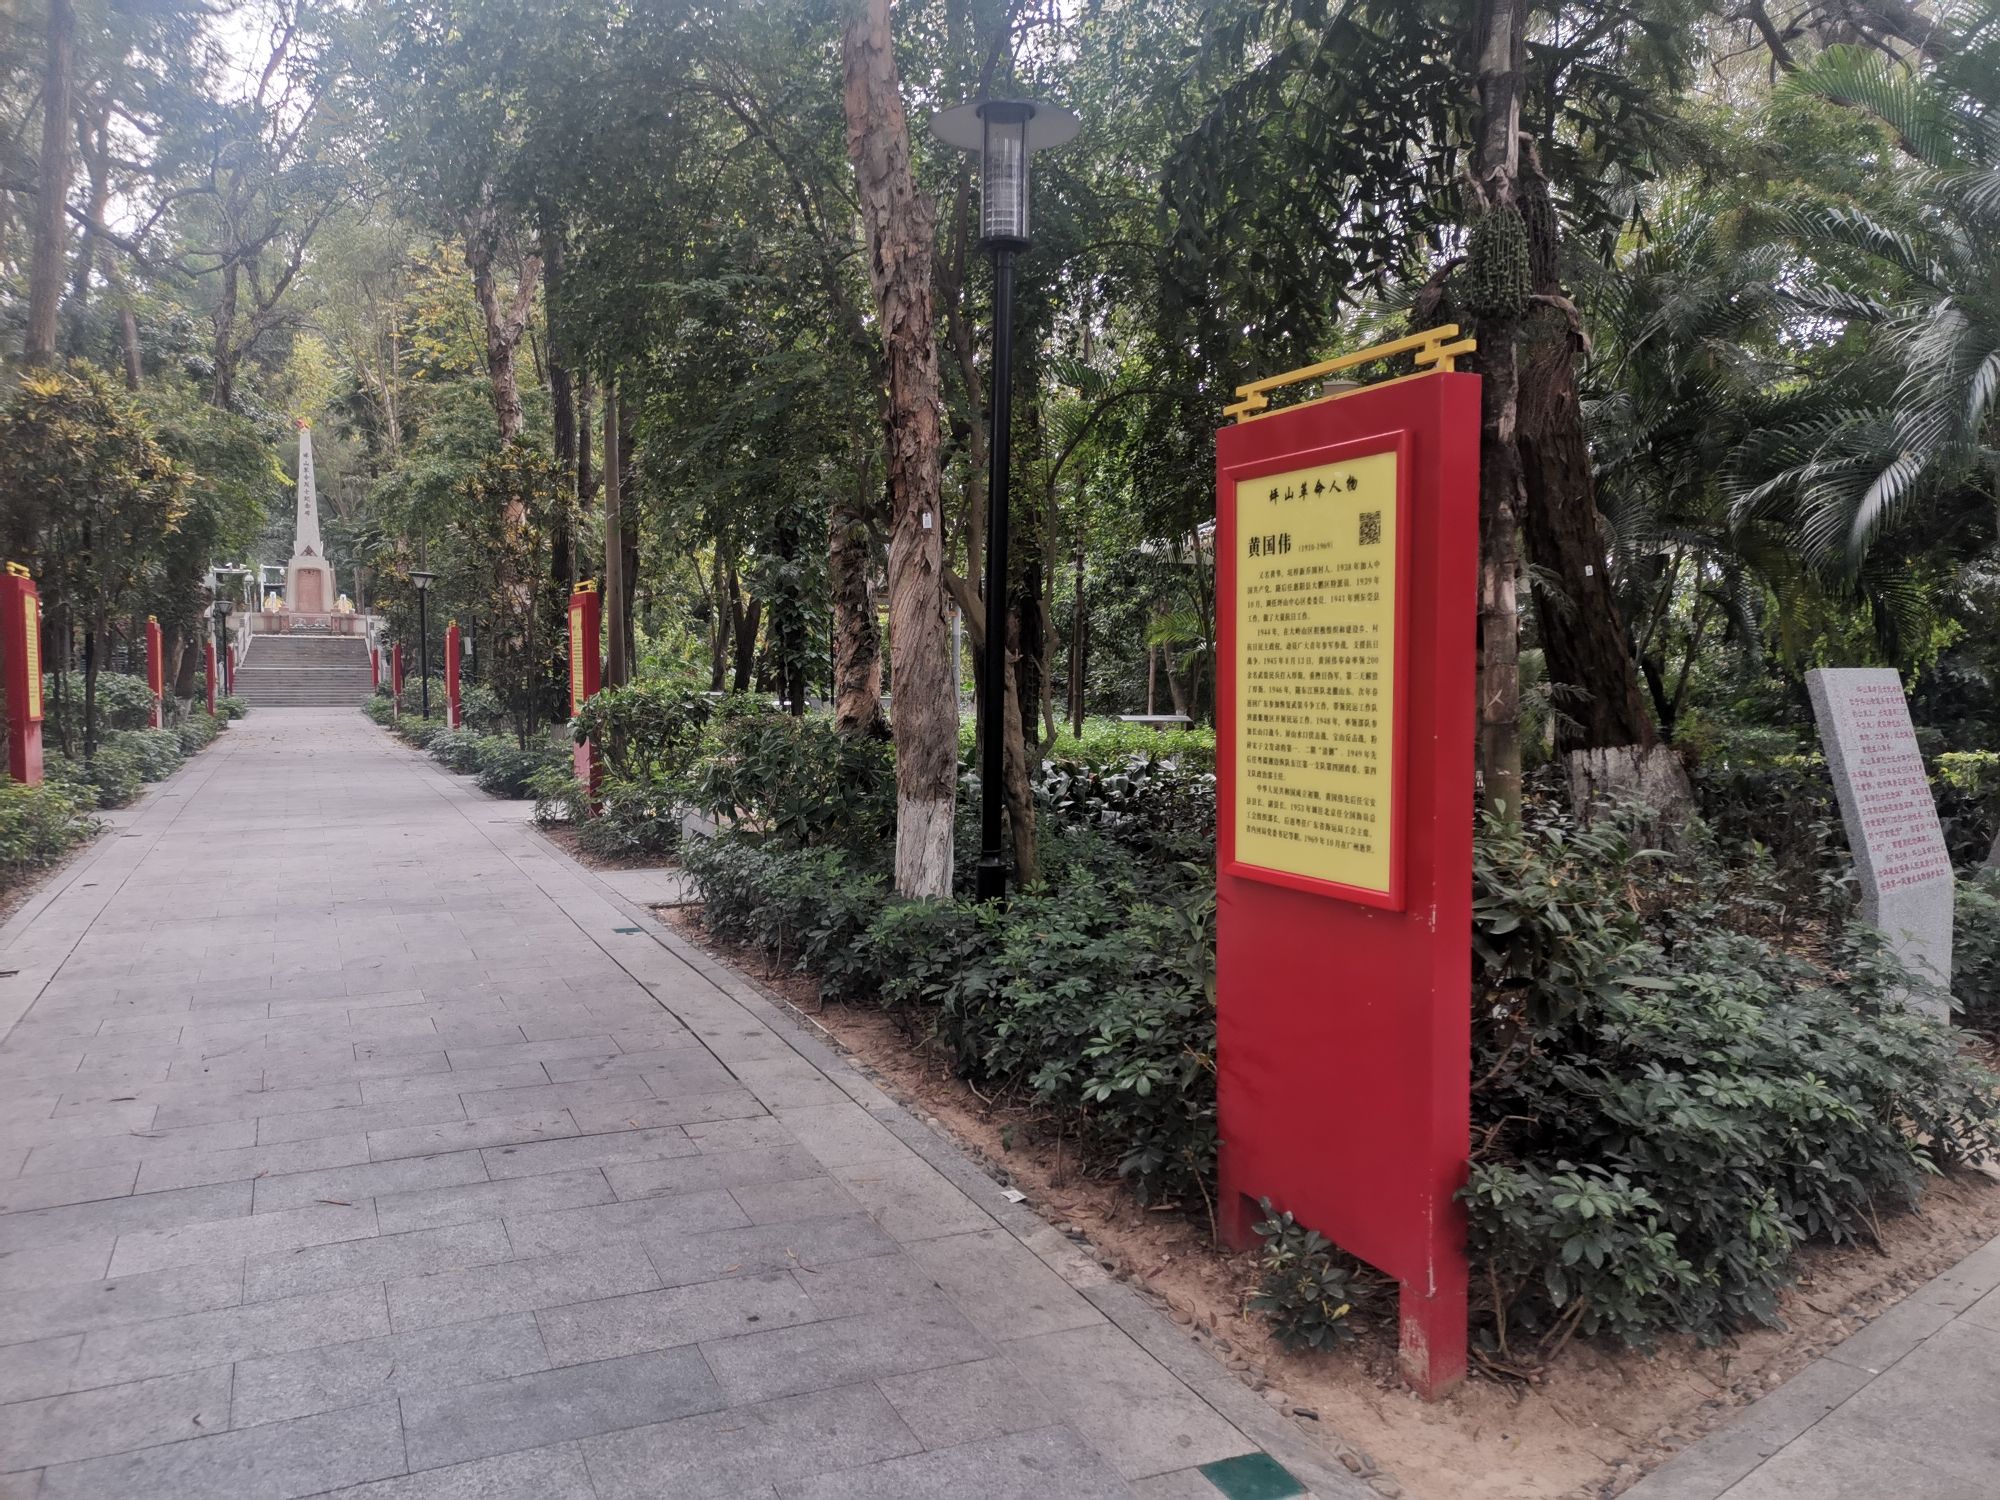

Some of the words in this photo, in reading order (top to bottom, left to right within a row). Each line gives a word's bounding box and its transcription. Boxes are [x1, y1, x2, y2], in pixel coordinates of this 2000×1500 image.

[1269, 473, 1358, 505] 坪山革命人物
[1248, 533, 1291, 558] 黄国伟
